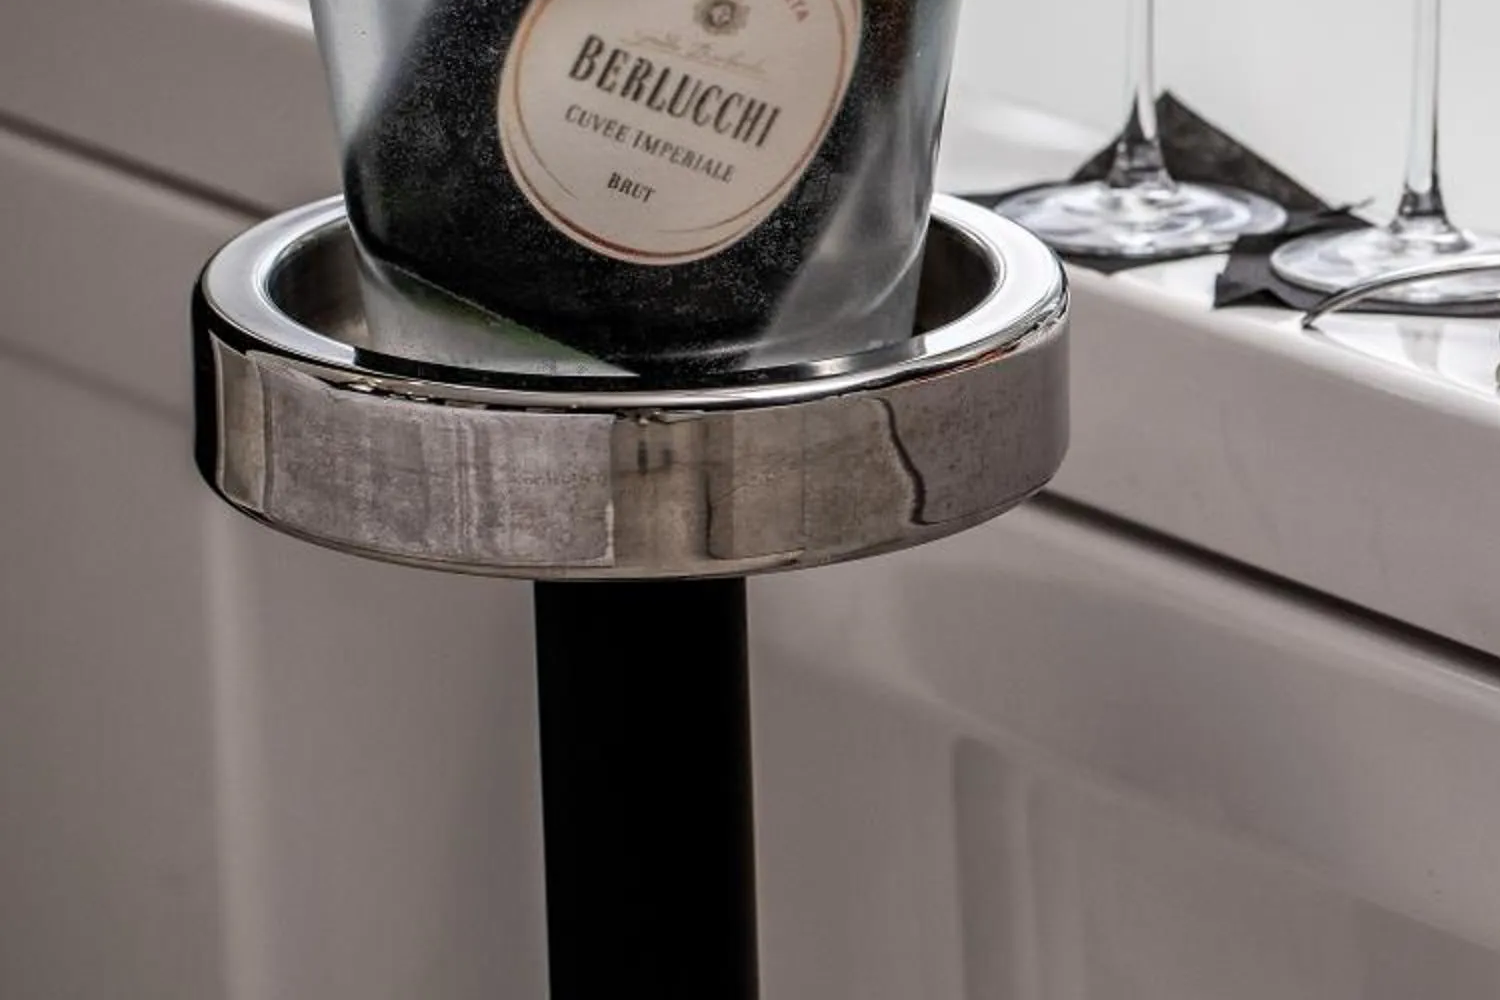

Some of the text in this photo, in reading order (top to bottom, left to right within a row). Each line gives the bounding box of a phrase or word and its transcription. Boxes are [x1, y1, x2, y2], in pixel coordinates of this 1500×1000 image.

[568, 32, 782, 149] BERLUCCHI
[632, 129, 736, 184] IMPERIALE
[606, 171, 657, 203] BRUT
